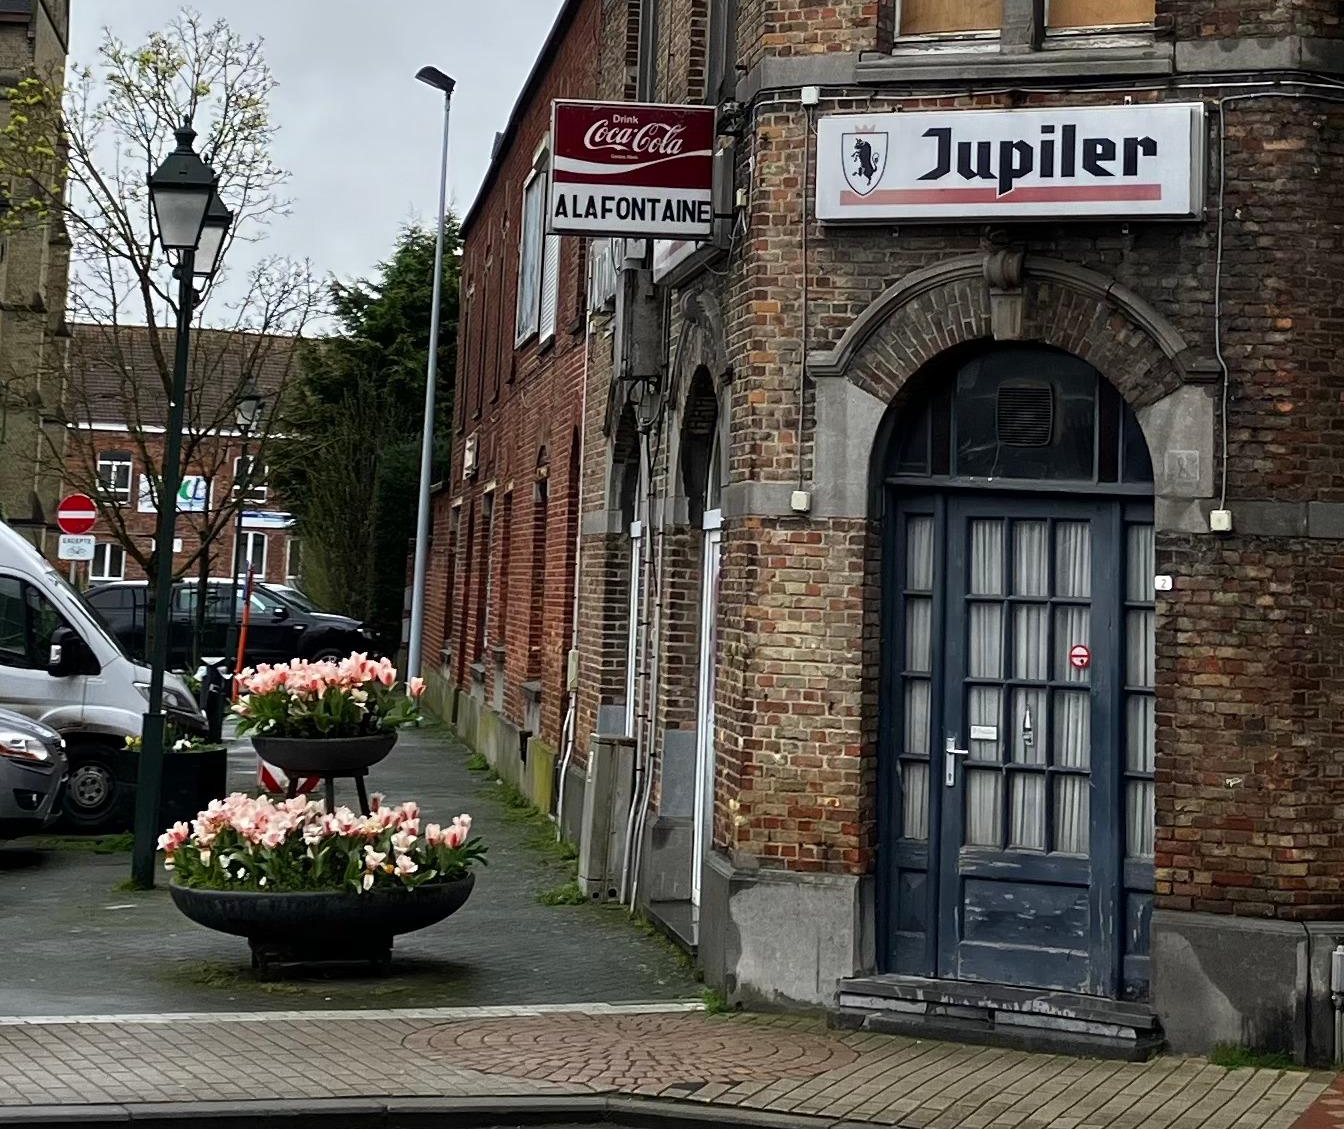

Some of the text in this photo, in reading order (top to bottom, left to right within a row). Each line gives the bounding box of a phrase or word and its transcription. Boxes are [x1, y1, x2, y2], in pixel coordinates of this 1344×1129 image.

[613, 114, 639, 124] Drink
[583, 119, 687, 154] Coca-Cola
[916, 124, 1158, 196] Jupiler
[1161, 579, 1167, 588] 2
